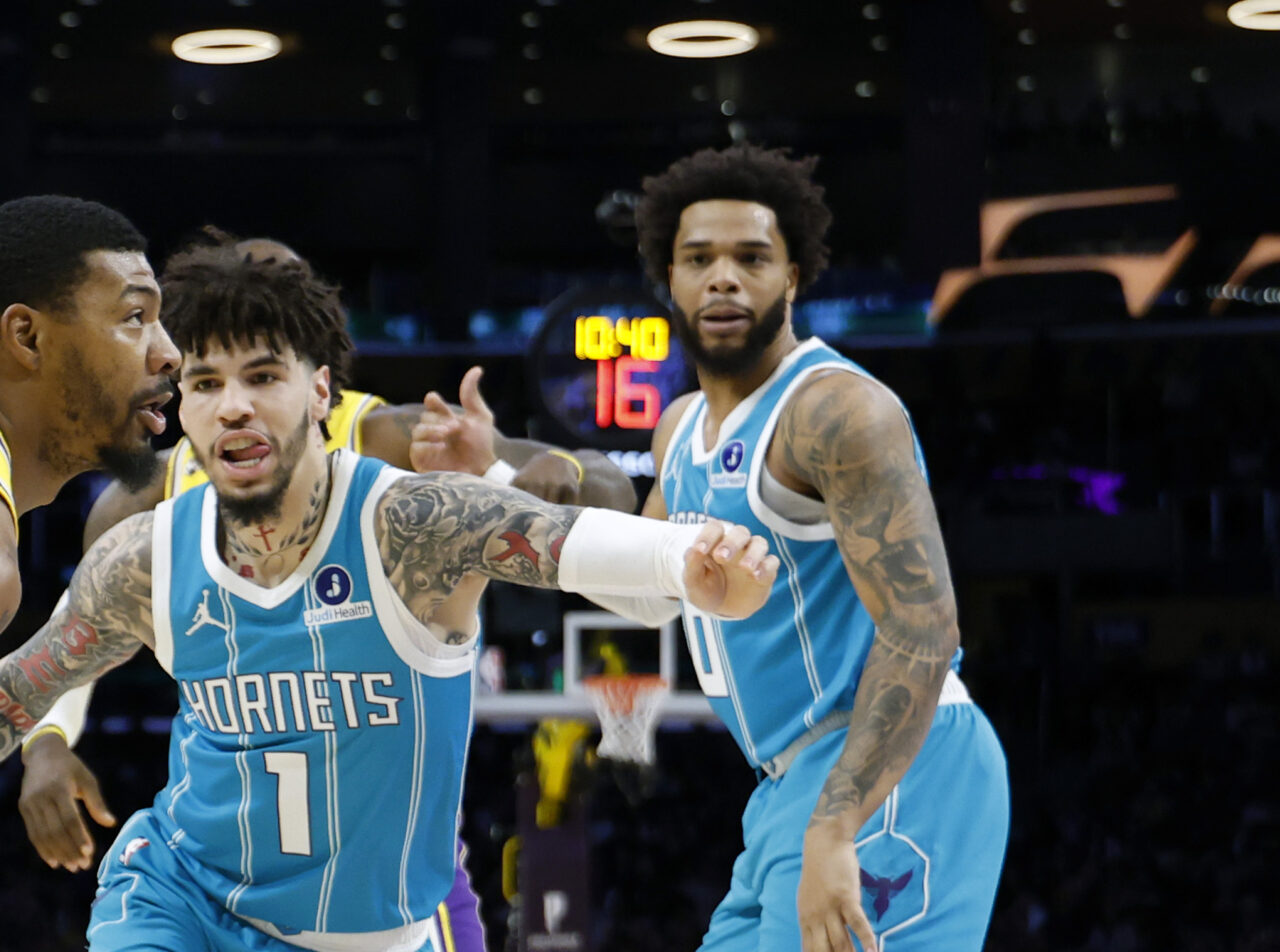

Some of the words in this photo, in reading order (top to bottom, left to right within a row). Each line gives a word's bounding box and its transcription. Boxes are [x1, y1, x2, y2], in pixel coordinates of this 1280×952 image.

[575, 316, 669, 361] 10:40
[596, 355, 661, 429] 16
[307, 608, 333, 624] Judi
[334, 603, 370, 619] Health
[181, 671, 404, 734] HORNETS
[263, 751, 313, 857] 1
